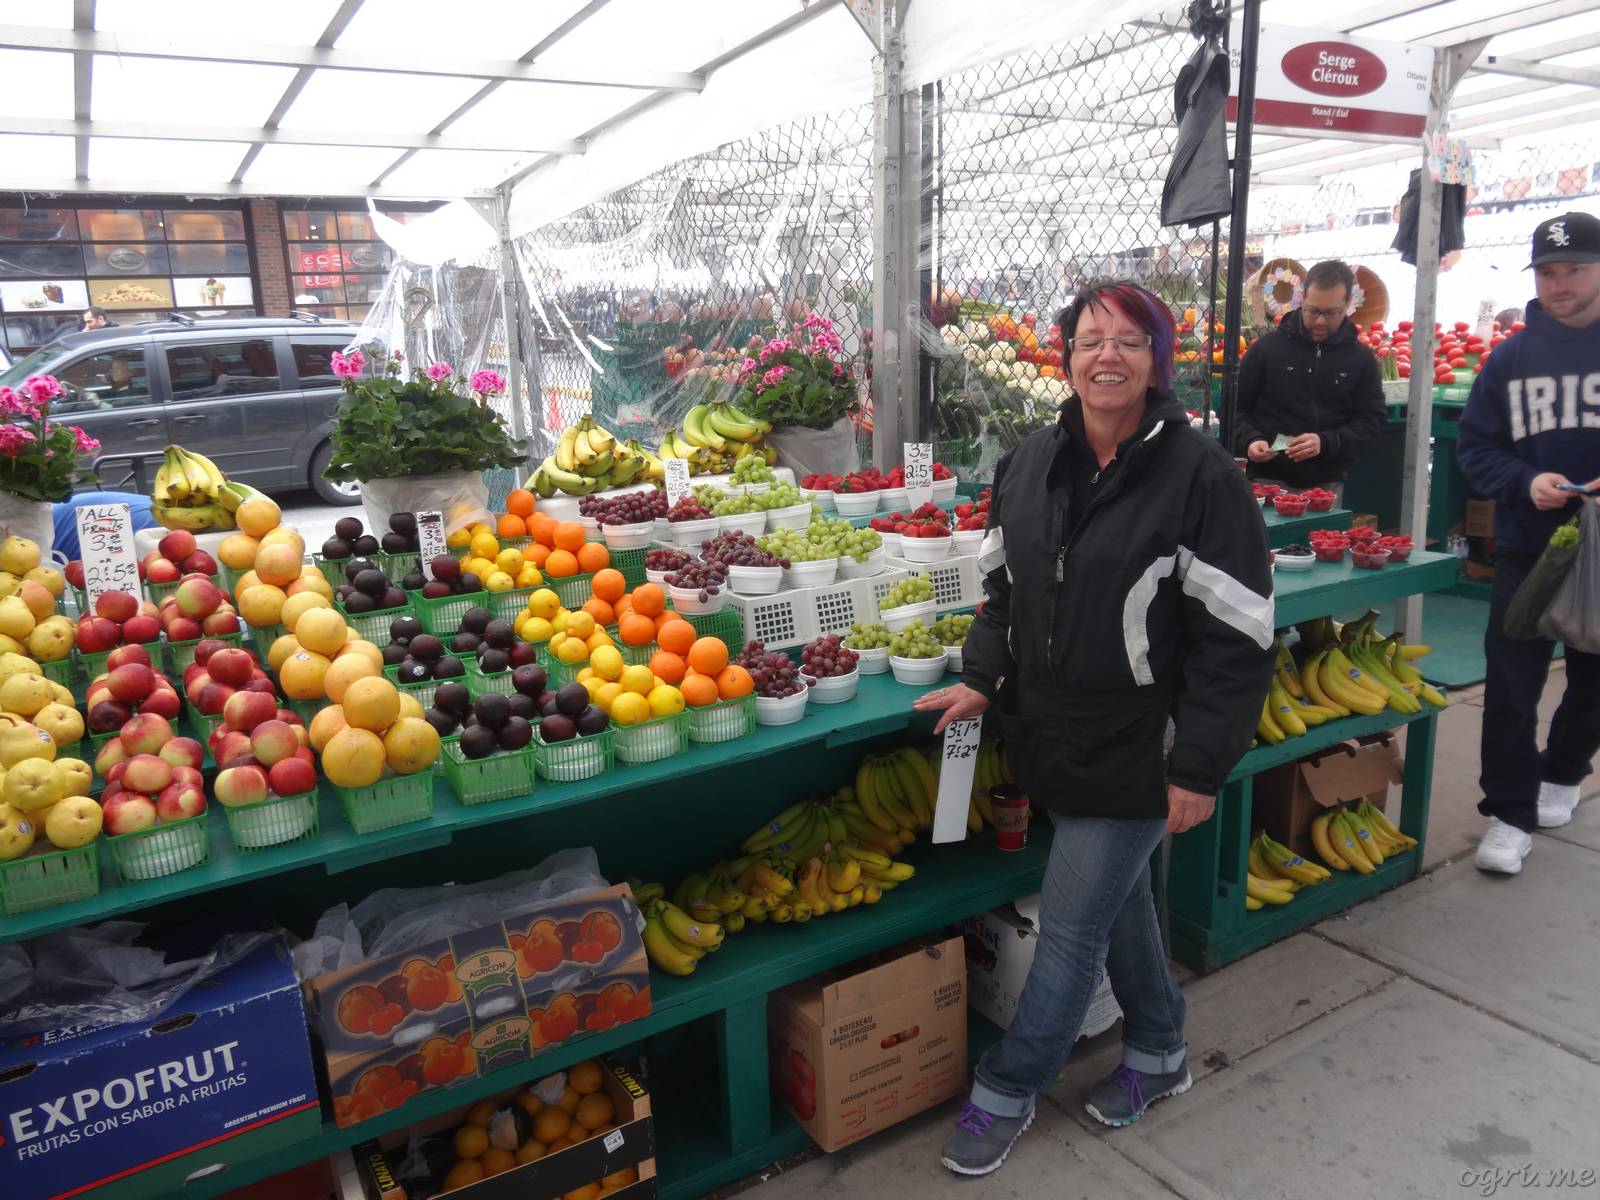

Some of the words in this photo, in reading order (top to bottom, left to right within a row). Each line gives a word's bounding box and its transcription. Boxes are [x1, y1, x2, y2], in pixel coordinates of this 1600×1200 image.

[1319, 51, 1356, 71] Serge
[1312, 67, 1360, 86] Cléroux
[1312, 107, 1331, 116] Stand
[85, 508, 118, 521] ALL
[469, 961, 507, 979] AGRICOM
[838, 1014, 873, 1035] BOISSEAU
[483, 1028, 521, 1046] AGRICOM
[9, 1041, 239, 1144] EXPOFRUT
[18, 1129, 81, 1161] FRUTAS
[83, 1116, 119, 1138] CON
[121, 1098, 176, 1125] SABOR
[178, 1093, 191, 1107] A
[191, 1073, 248, 1102] FRUTAS
[224, 1111, 258, 1129] ARGENTINE
[288, 1093, 307, 1105] FRUIT
